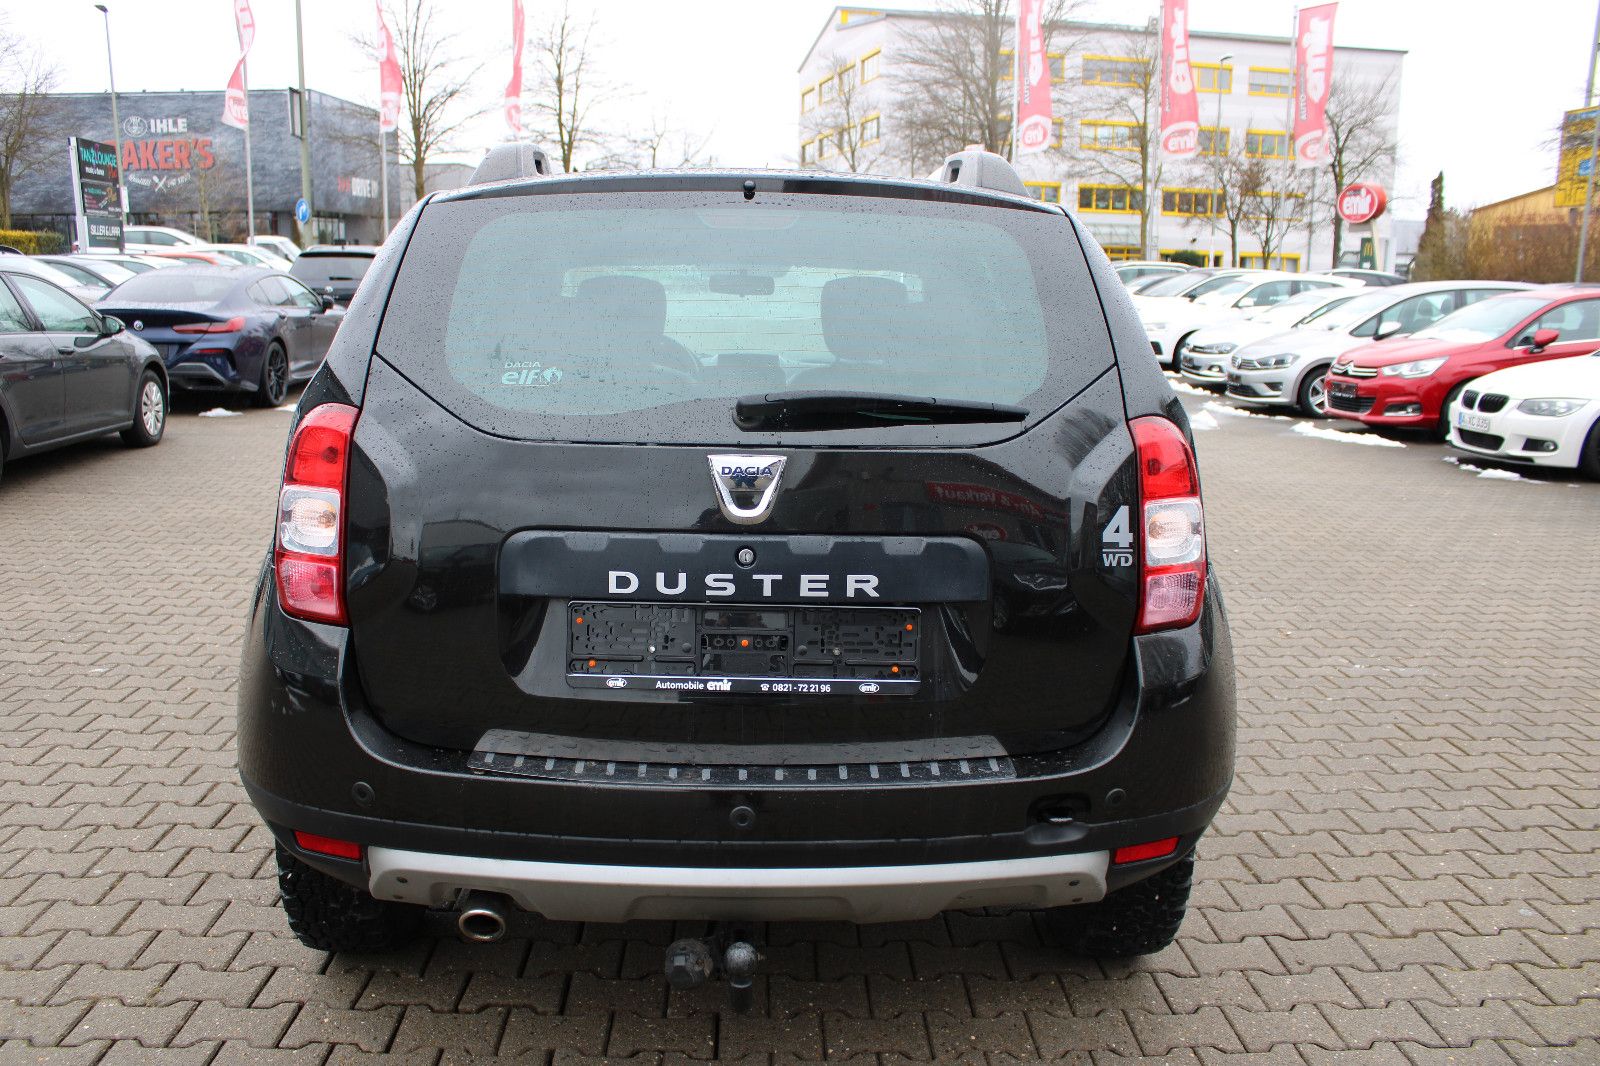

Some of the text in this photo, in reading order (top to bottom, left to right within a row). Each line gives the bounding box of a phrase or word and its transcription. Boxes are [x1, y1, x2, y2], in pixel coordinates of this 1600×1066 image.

[150, 118, 187, 133] IHLE
[103, 138, 215, 171] AKER'S
[1343, 188, 1372, 215] emir
[501, 369, 541, 385] elf
[721, 466, 773, 477] DACIA
[1103, 505, 1133, 547] 4
[1103, 553, 1133, 567] WD
[608, 570, 880, 598] DUSTER
[655, 679, 732, 691] Automobile emir
